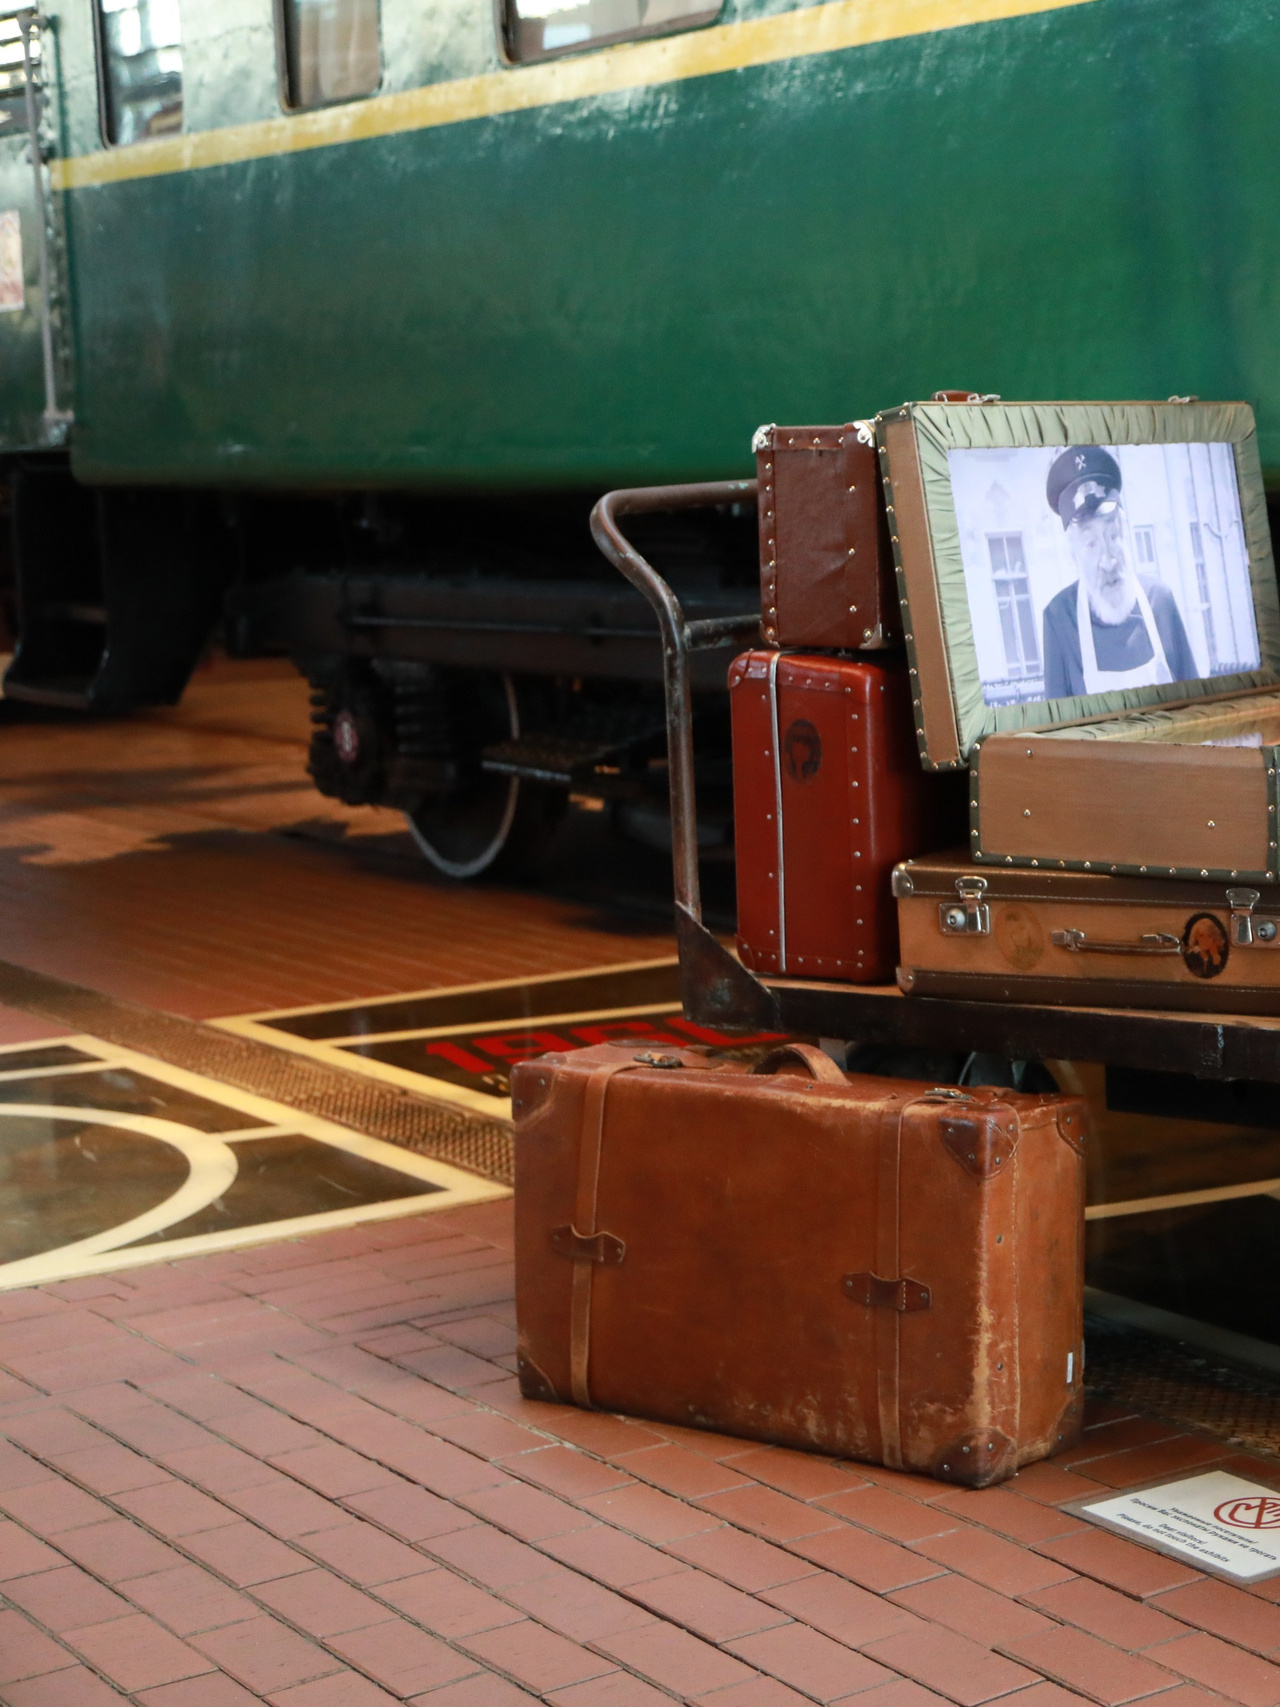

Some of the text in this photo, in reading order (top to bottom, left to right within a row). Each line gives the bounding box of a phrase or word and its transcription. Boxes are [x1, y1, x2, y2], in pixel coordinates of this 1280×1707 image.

[1130, 1498, 1159, 1511] Просим
[1170, 1515, 1211, 1532] экспонаты
[1249, 1547, 1277, 1560] трогать
[1158, 1523, 1208, 1545] Dear visitors!
[1168, 1507, 1212, 1526] Уважаемые
[1116, 1513, 1142, 1525] Please,
[1164, 1533, 1187, 1543] touch
[1185, 1542, 1201, 1550] the
[1198, 1548, 1230, 1562] exhibits
